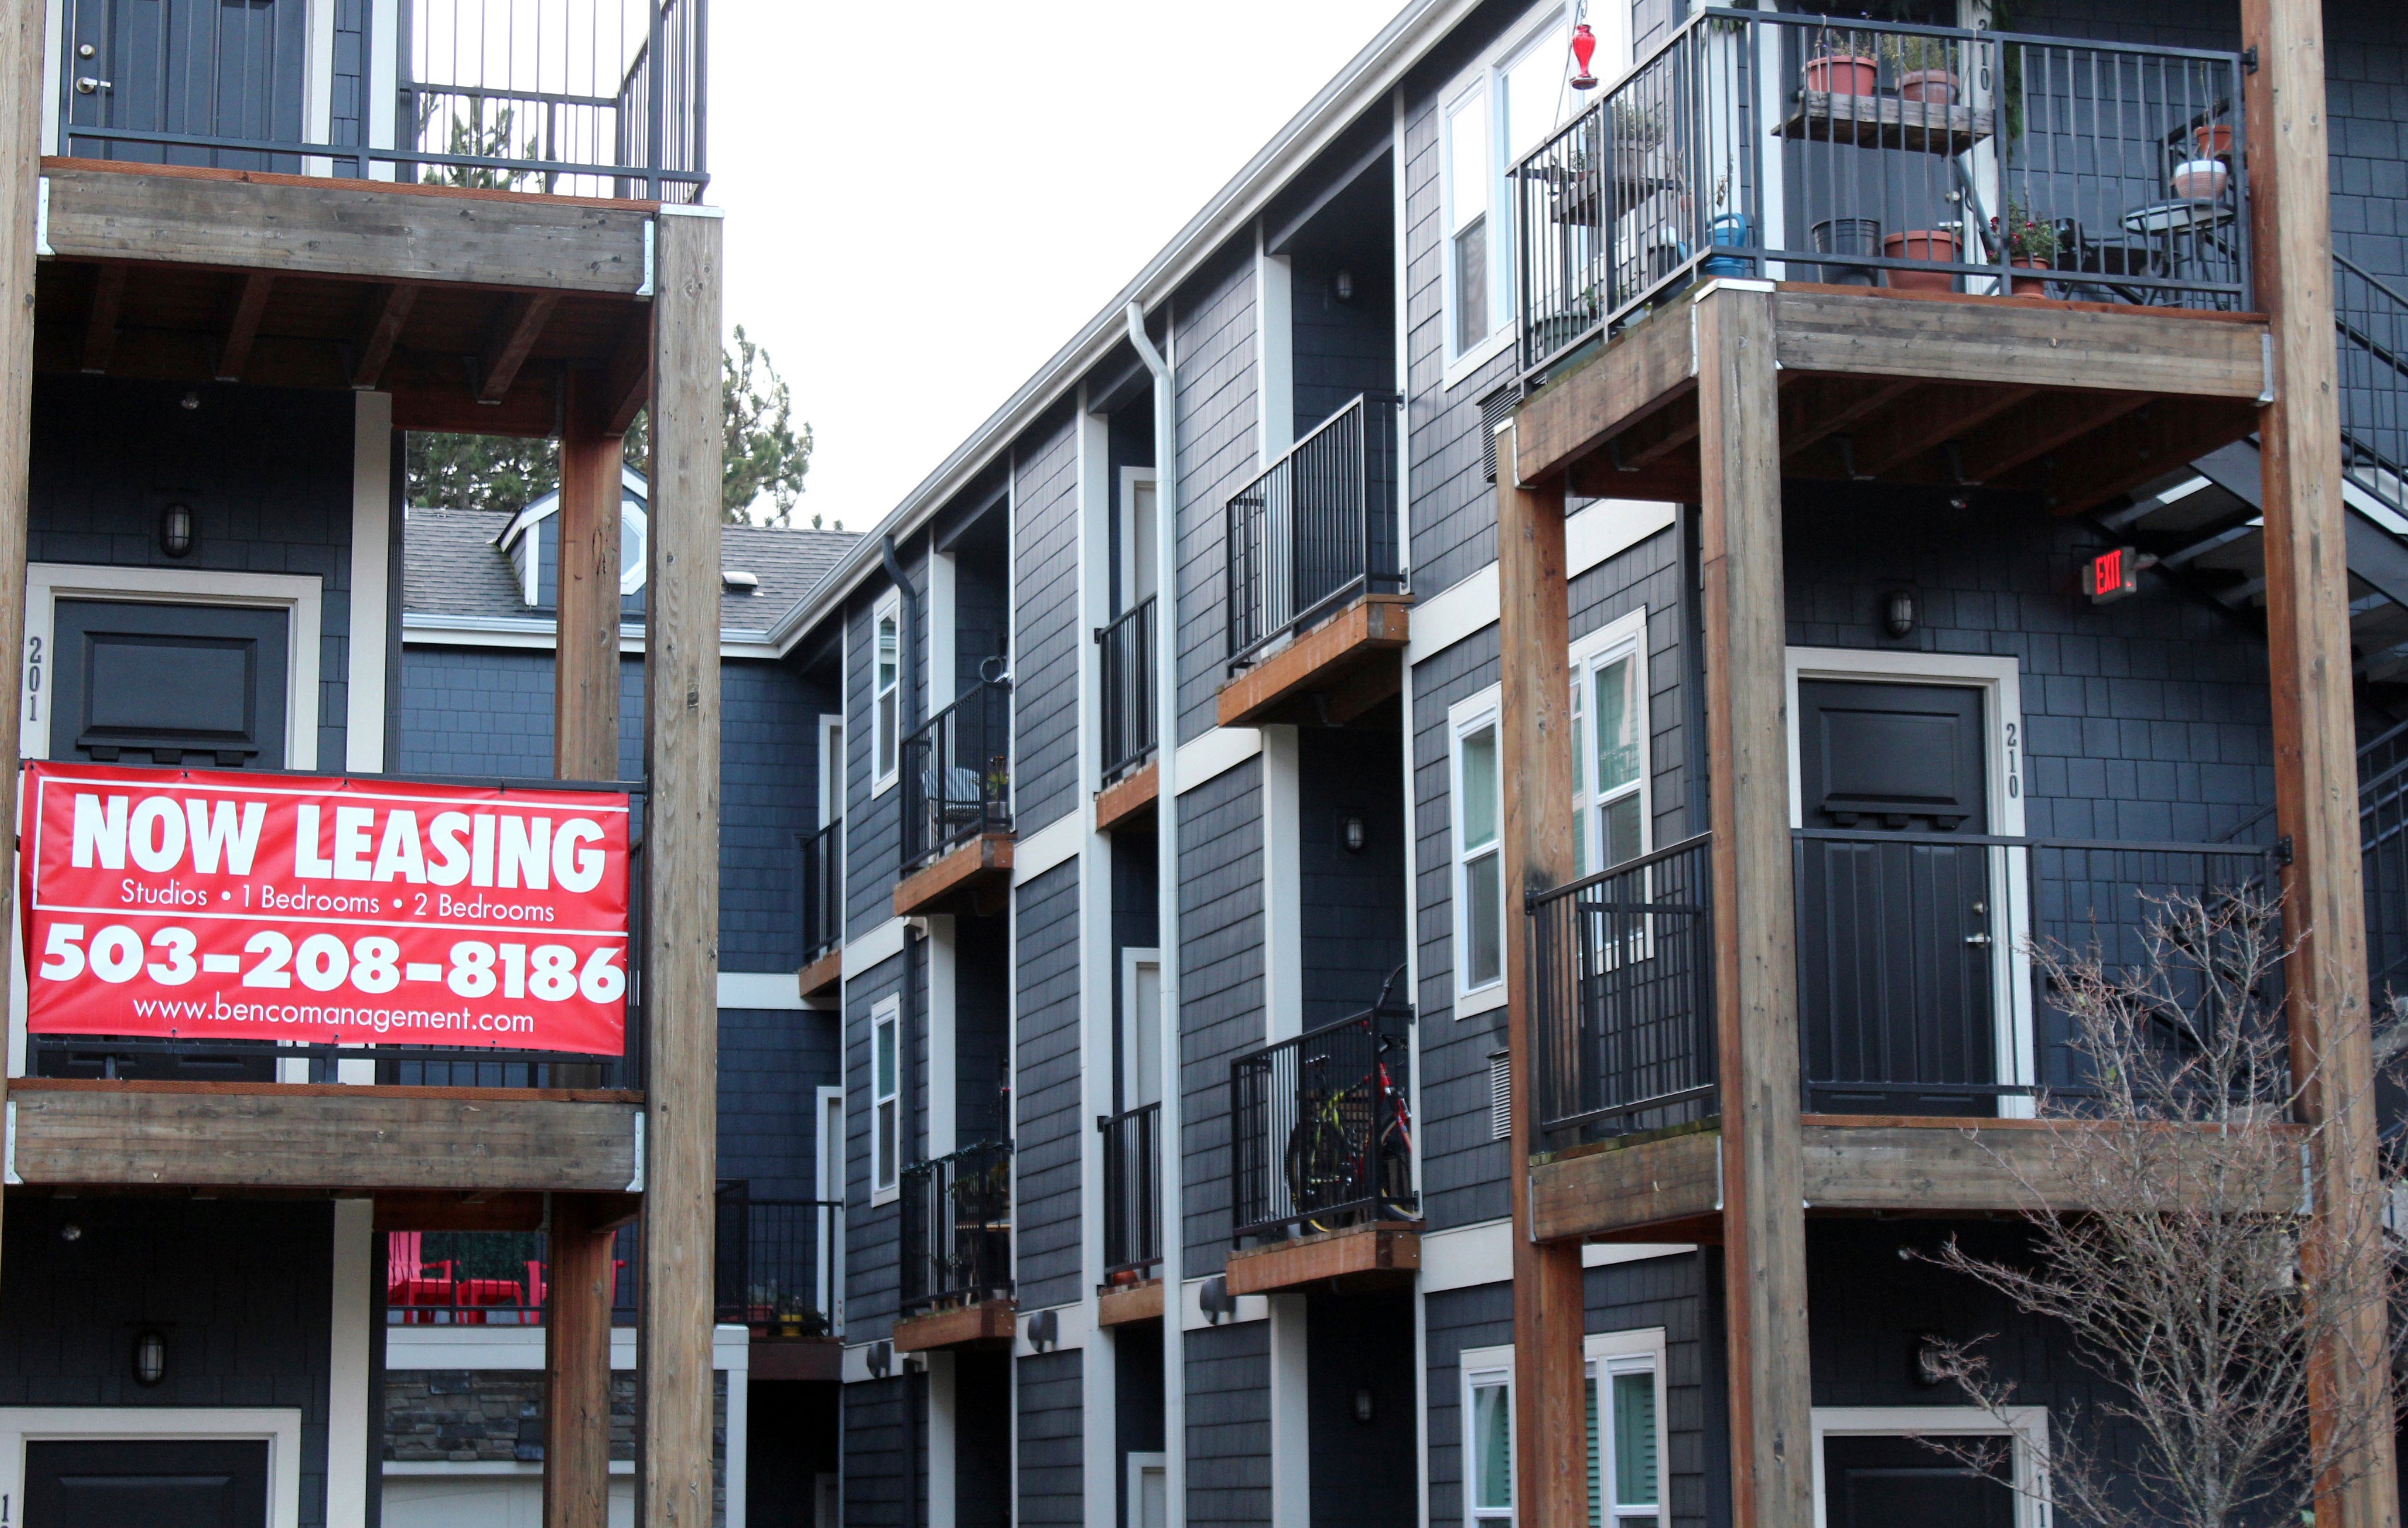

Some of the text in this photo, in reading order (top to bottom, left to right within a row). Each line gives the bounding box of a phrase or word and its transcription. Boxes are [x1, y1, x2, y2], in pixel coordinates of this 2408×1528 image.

[2095, 549, 2122, 595] EXIT
[29, 636, 42, 722] 201
[2007, 722, 2019, 799] 210
[71, 793, 606, 893] NOW LEASING
[121, 878, 555, 922] Studios 1 Bedrooms 2 Bedrooms
[39, 922, 626, 1004] 503-208-8186
[133, 992, 534, 1033] www.bencomanagement.com
